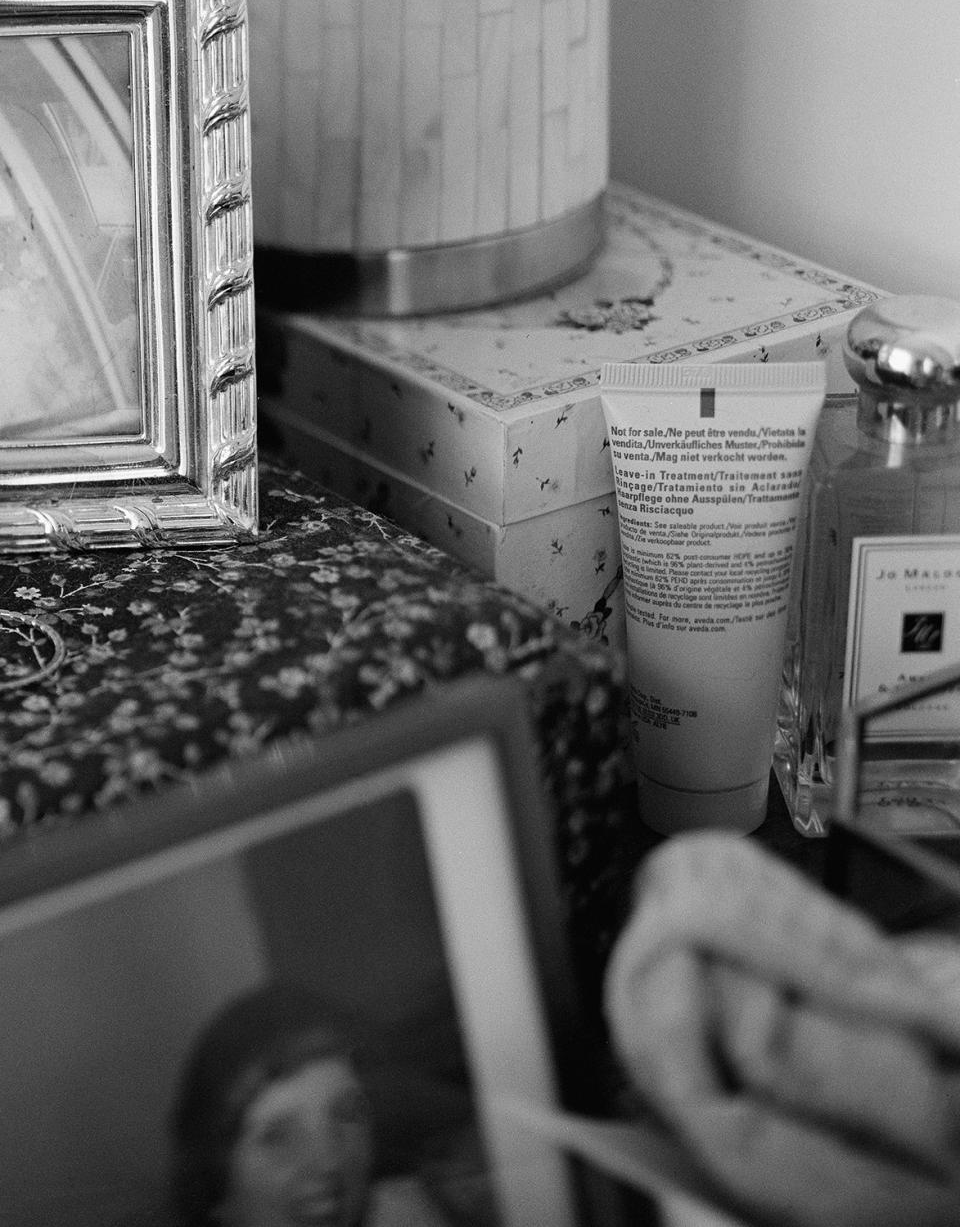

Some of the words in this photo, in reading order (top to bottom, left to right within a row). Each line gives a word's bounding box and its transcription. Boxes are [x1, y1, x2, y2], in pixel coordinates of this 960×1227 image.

[611, 426, 626, 436] Not
[628, 427, 641, 437] for
[643, 427, 682, 438] sale./Ne
[684, 428, 705, 440] peut
[707, 428, 725, 438] être
[624, 452, 678, 464] venta./Mag
[680, 452, 699, 462] niet
[701, 452, 744, 462] verkocht
[747, 452, 788, 462] worden.
[615, 465, 656, 480] Leave-in
[660, 470, 777, 481] Treatment/Traitement
[616, 476, 723, 493] Rinçage/Tratamiento
[729, 483, 745, 492] sin
[665, 493, 689, 503] ohne
[640, 503, 694, 517] Risciacquo
[654, 521, 667, 529] See
[669, 522, 697, 530] saleable
[639, 528, 647, 536] de
[647, 538, 684, 546] verkoopbaar
[637, 550, 664, 559] minimum
[669, 568, 689, 576] Please
[668, 593, 698, 602] recyclage
[659, 613, 669, 621] For
